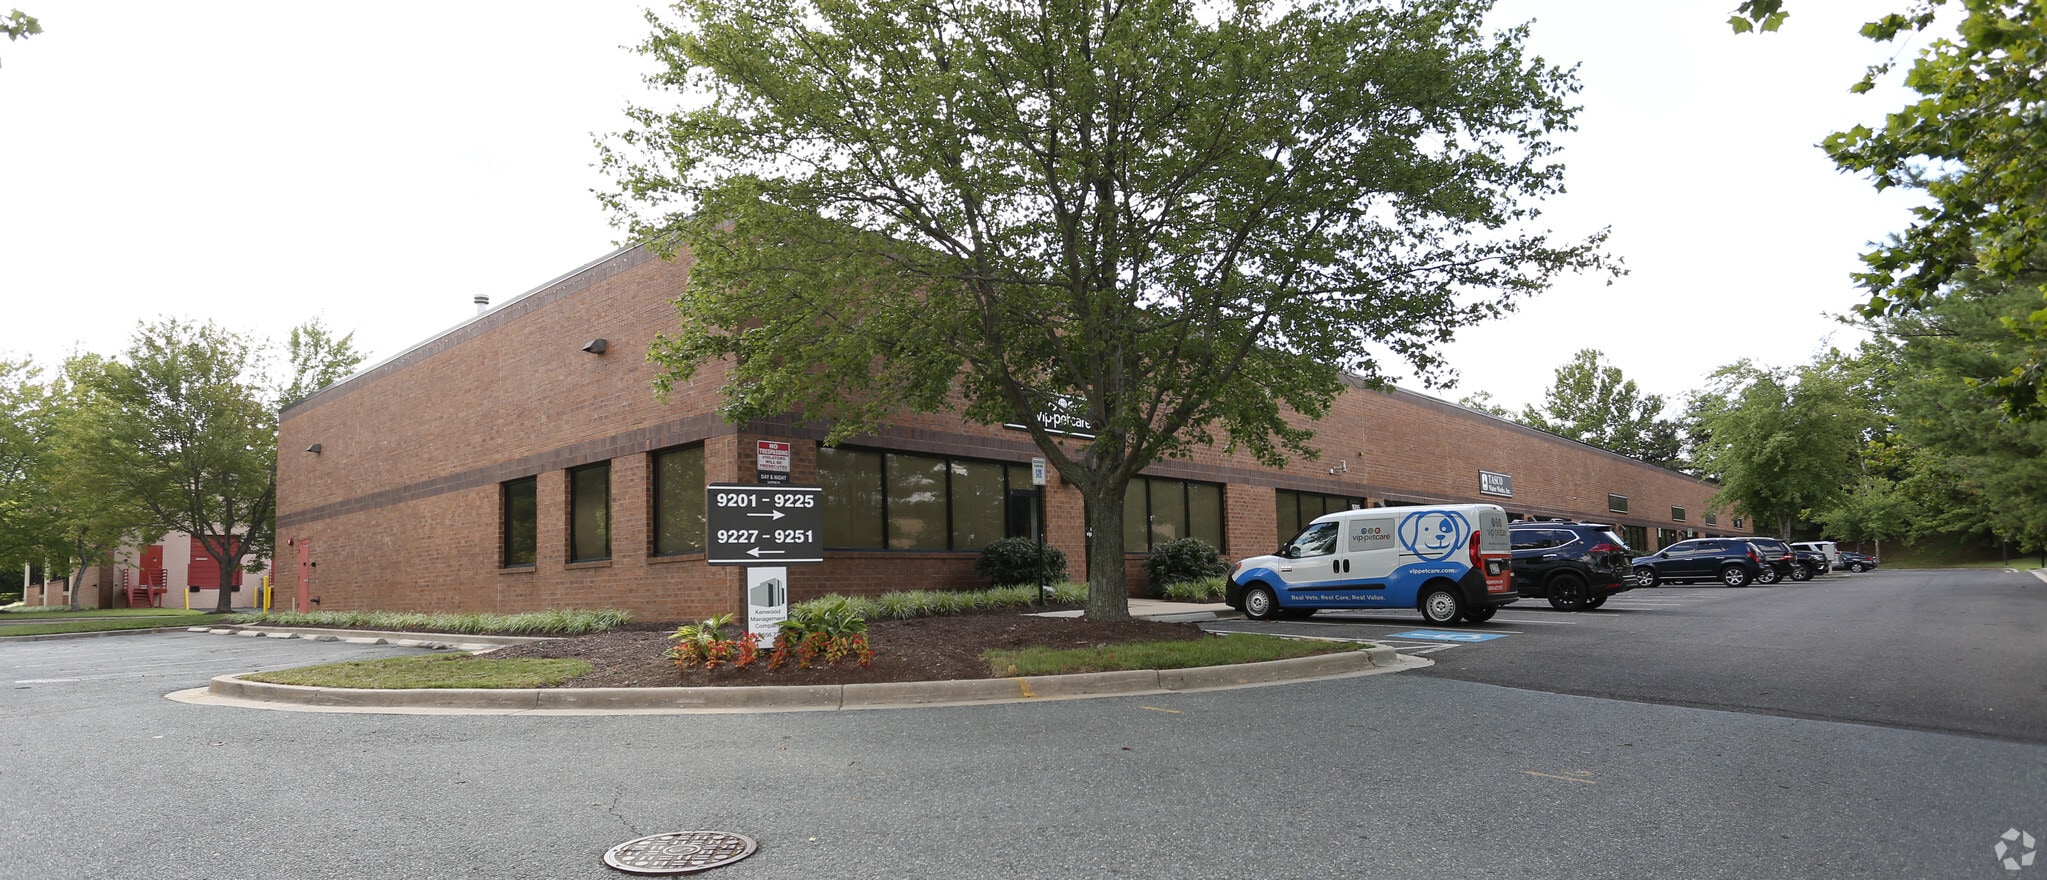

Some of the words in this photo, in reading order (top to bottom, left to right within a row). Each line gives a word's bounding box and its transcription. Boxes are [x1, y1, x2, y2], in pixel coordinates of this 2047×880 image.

[716, 493, 757, 508] 9201
[774, 494, 814, 508] 9225
[717, 529, 759, 544] 9227
[774, 529, 813, 543] 9251
